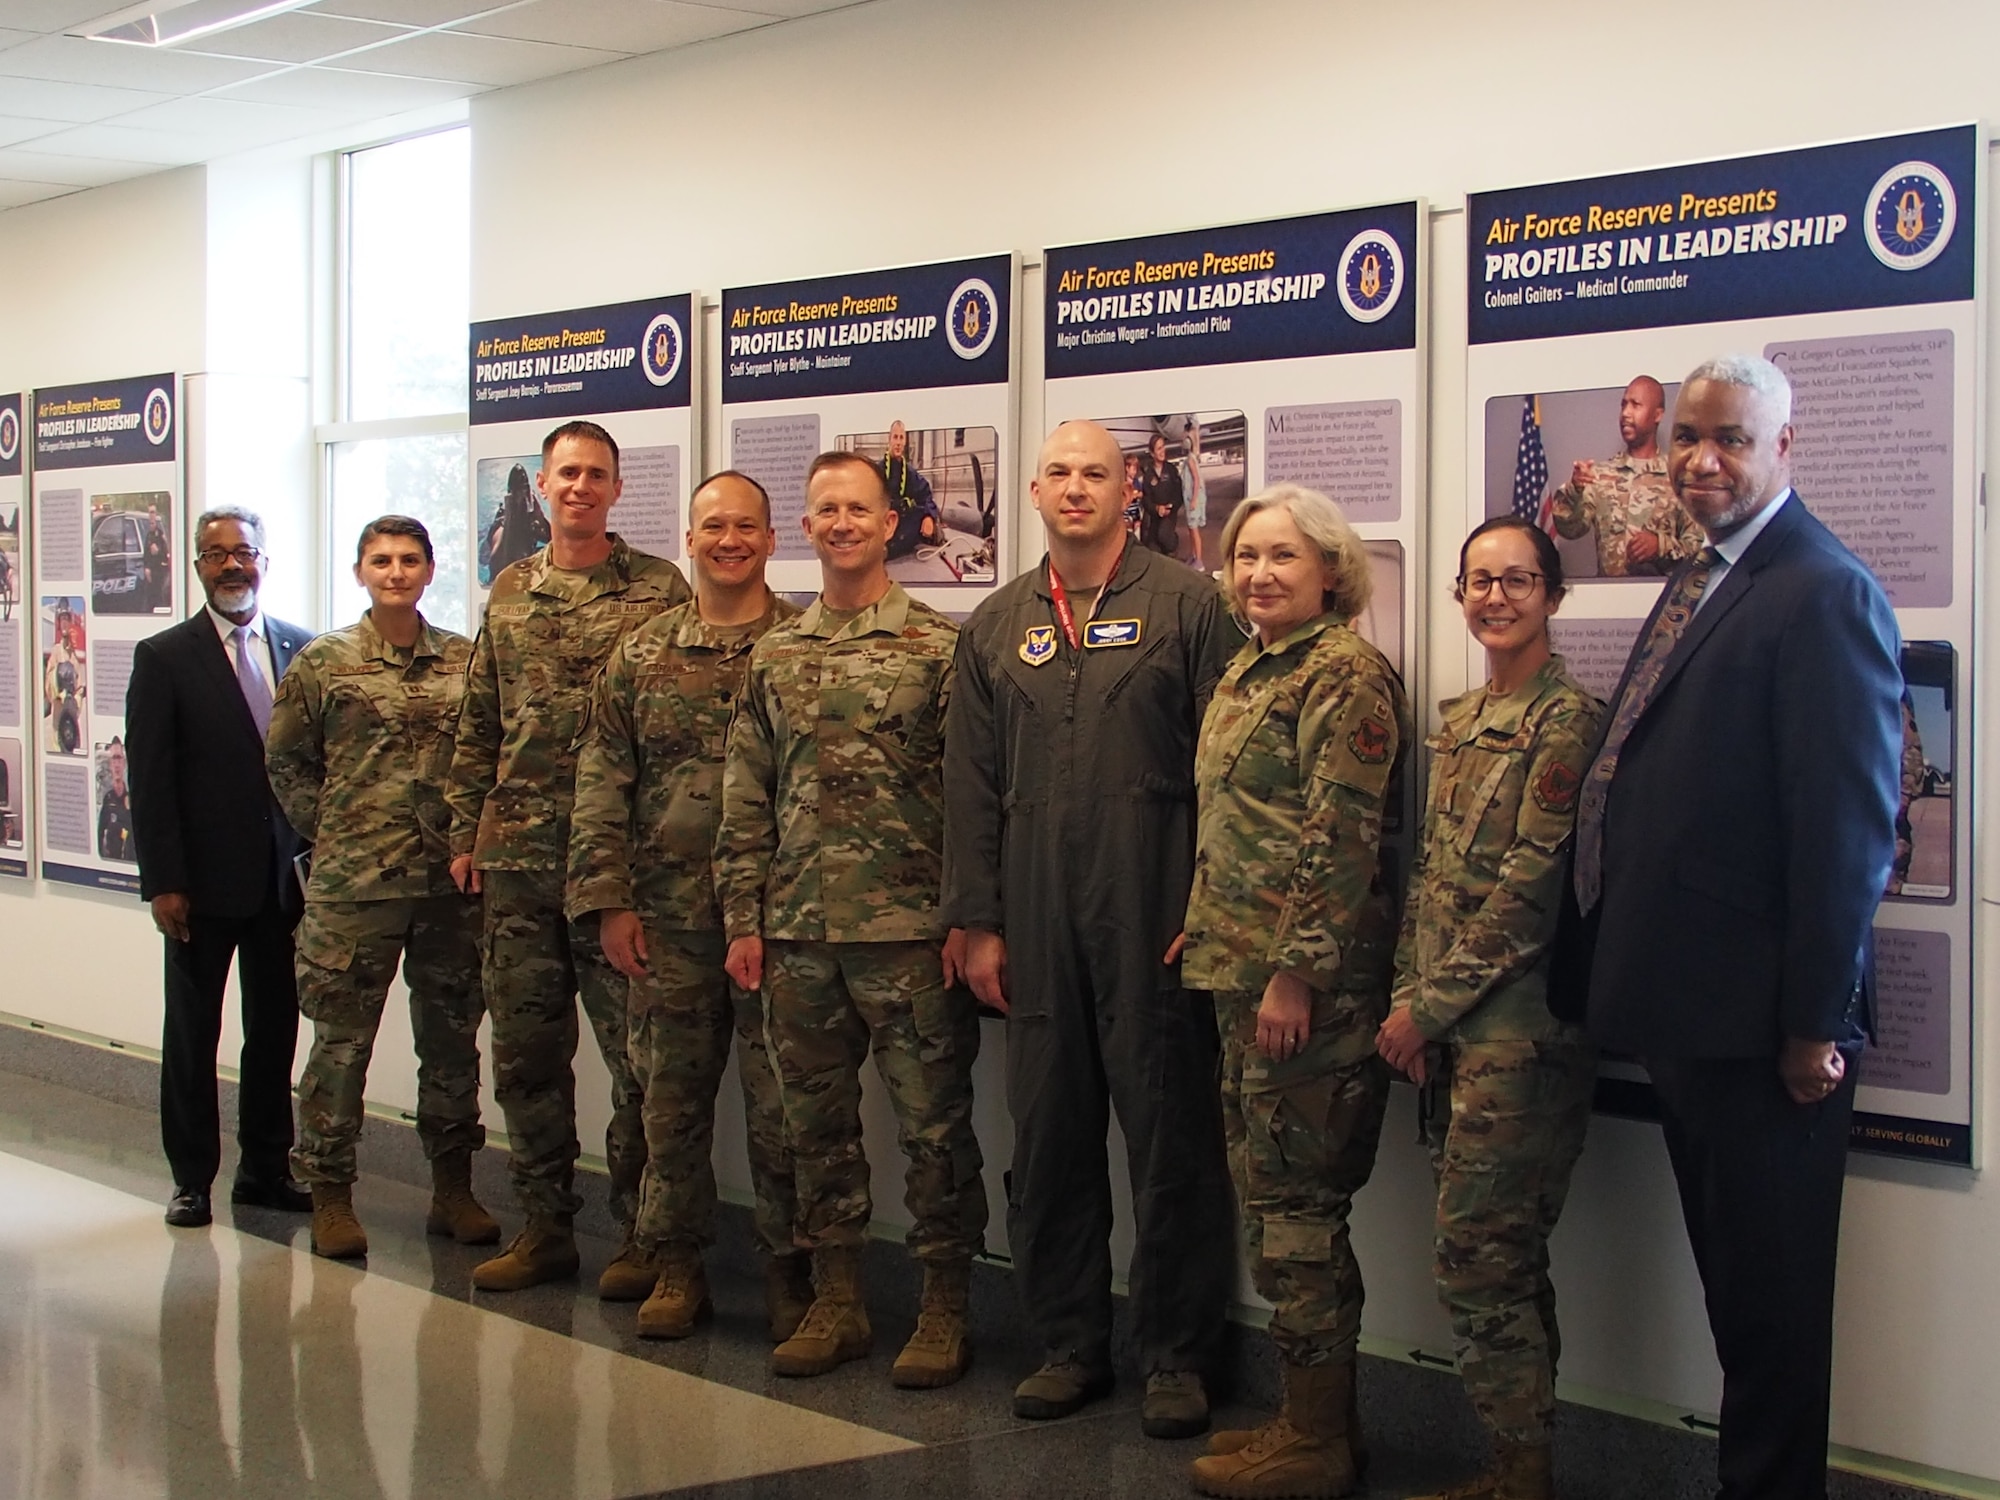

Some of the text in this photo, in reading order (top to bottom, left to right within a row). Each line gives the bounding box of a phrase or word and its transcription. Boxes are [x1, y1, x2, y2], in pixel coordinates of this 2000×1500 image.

[1487, 187, 1777, 245] Air Force Reserve Presents
[1485, 241, 1612, 281] PROFILES
[1619, 236, 1649, 266] IN
[1658, 214, 1848, 262] LEADERSHIP
[1059, 250, 1275, 292] Air Force Reserve Presents
[1057, 273, 1325, 324] PROFILES IN LEADERSHIP
[1485, 286, 1523, 308] Colonel
[1525, 282, 1562, 304] Gaiters
[1577, 275, 1617, 299] Medical
[1621, 270, 1689, 295] Commander
[731, 294, 898, 328] Air Force Reserve Presents
[477, 328, 606, 358] Air Force Reserve Presents
[730, 316, 937, 357] PROFILES IN LEADERSHIP
[1057, 332, 1080, 350] Major
[1082, 328, 1116, 346] Christine
[1118, 326, 1149, 344] Wagner
[1157, 317, 1208, 337] Instructional
[1210, 317, 1231, 332] Pilot
[476, 347, 635, 383] PROFILES IN LEADERSHIP
[730, 360, 744, 376] Staff
[745, 362, 772, 378] Sergeant
[773, 359, 788, 376] Tyler
[49, 402, 66, 416] Force
[67, 399, 91, 414] Reserve
[93, 397, 121, 411] Presents
[38, 413, 141, 437] PROFILES IN LEADERSHIP
[1866, 1128, 1903, 1142] SERVING
[1905, 1132, 1952, 1148] GLOBALLY
